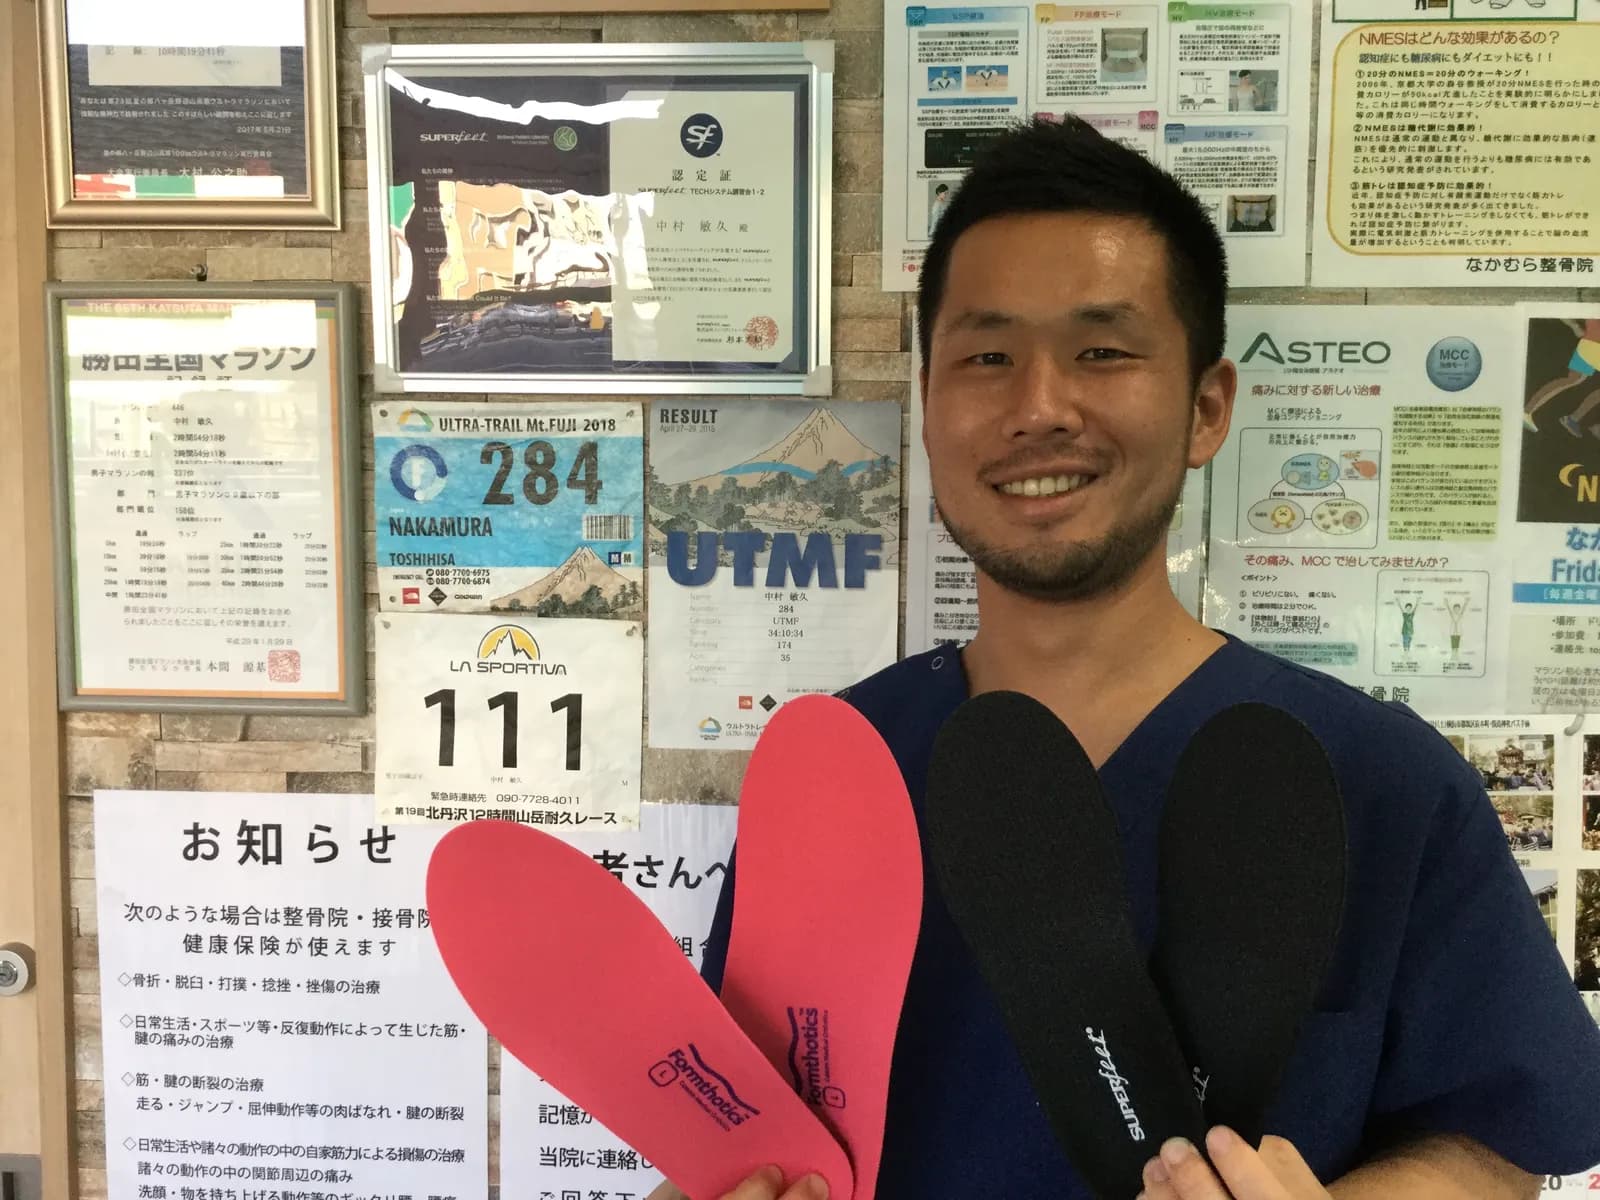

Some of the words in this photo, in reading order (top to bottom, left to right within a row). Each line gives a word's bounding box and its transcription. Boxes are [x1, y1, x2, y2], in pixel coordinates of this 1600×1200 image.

[1359, 30, 1560, 46] NMESはどんな効果があるの？
[671, 168, 732, 182] 認定証
[656, 219, 685, 233] 中村
[700, 219, 728, 233] 敏久
[1465, 256, 1594, 273] なかむら整骨院
[1239, 332, 1391, 365] ASTEO
[1439, 348, 1470, 361] MCC
[1251, 384, 1382, 397] 痛みに対する新しい治療
[659, 408, 719, 425] RESULT
[439, 418, 523, 433] ULTRA-TRAIL
[526, 418, 577, 433] Mt.FUJI
[583, 418, 617, 432] 2018
[479, 440, 604, 506] 284
[388, 516, 494, 537] NAKAMURA
[389, 552, 456, 566] TOSHIHISA
[666, 530, 885, 589] UTMF
[1551, 558, 1600, 583] Frid
[764, 591, 784, 602] 中村
[789, 591, 809, 602] 敏久
[778, 604, 794, 613] 284
[772, 617, 800, 626] UTMF
[767, 628, 804, 638] 34:10:34
[777, 641, 792, 650] 174
[780, 653, 791, 662] 35
[206, 660, 230, 673] 本間
[450, 660, 472, 673] LA
[476, 661, 568, 676] SPORTIVA
[423, 688, 583, 771] 111
[430, 791, 487, 803] 緊急時連絡先
[495, 793, 581, 805] 090-7728-4011
[182, 819, 397, 866] お知らせ
[123, 901, 432, 930] 次のような場合は整骨院・接骨院
[182, 933, 397, 958] 健康保険が使えます
[133, 1030, 235, 1050] 腱の痛みの治療
[135, 1072, 265, 1093] 筋・腱の断裂の治療
[667, 1048, 746, 1126] Formthotics
[1085, 1029, 1146, 1142] SUPERfeet
[136, 1096, 465, 1122] 走る・ジャンプ・屈伸動作等の肉ばなれ・腱の断裂
[538, 1146, 655, 1171] 当院に連絡し
[137, 1161, 354, 1184] 諸々の動作の中の関節周辺の痛み
